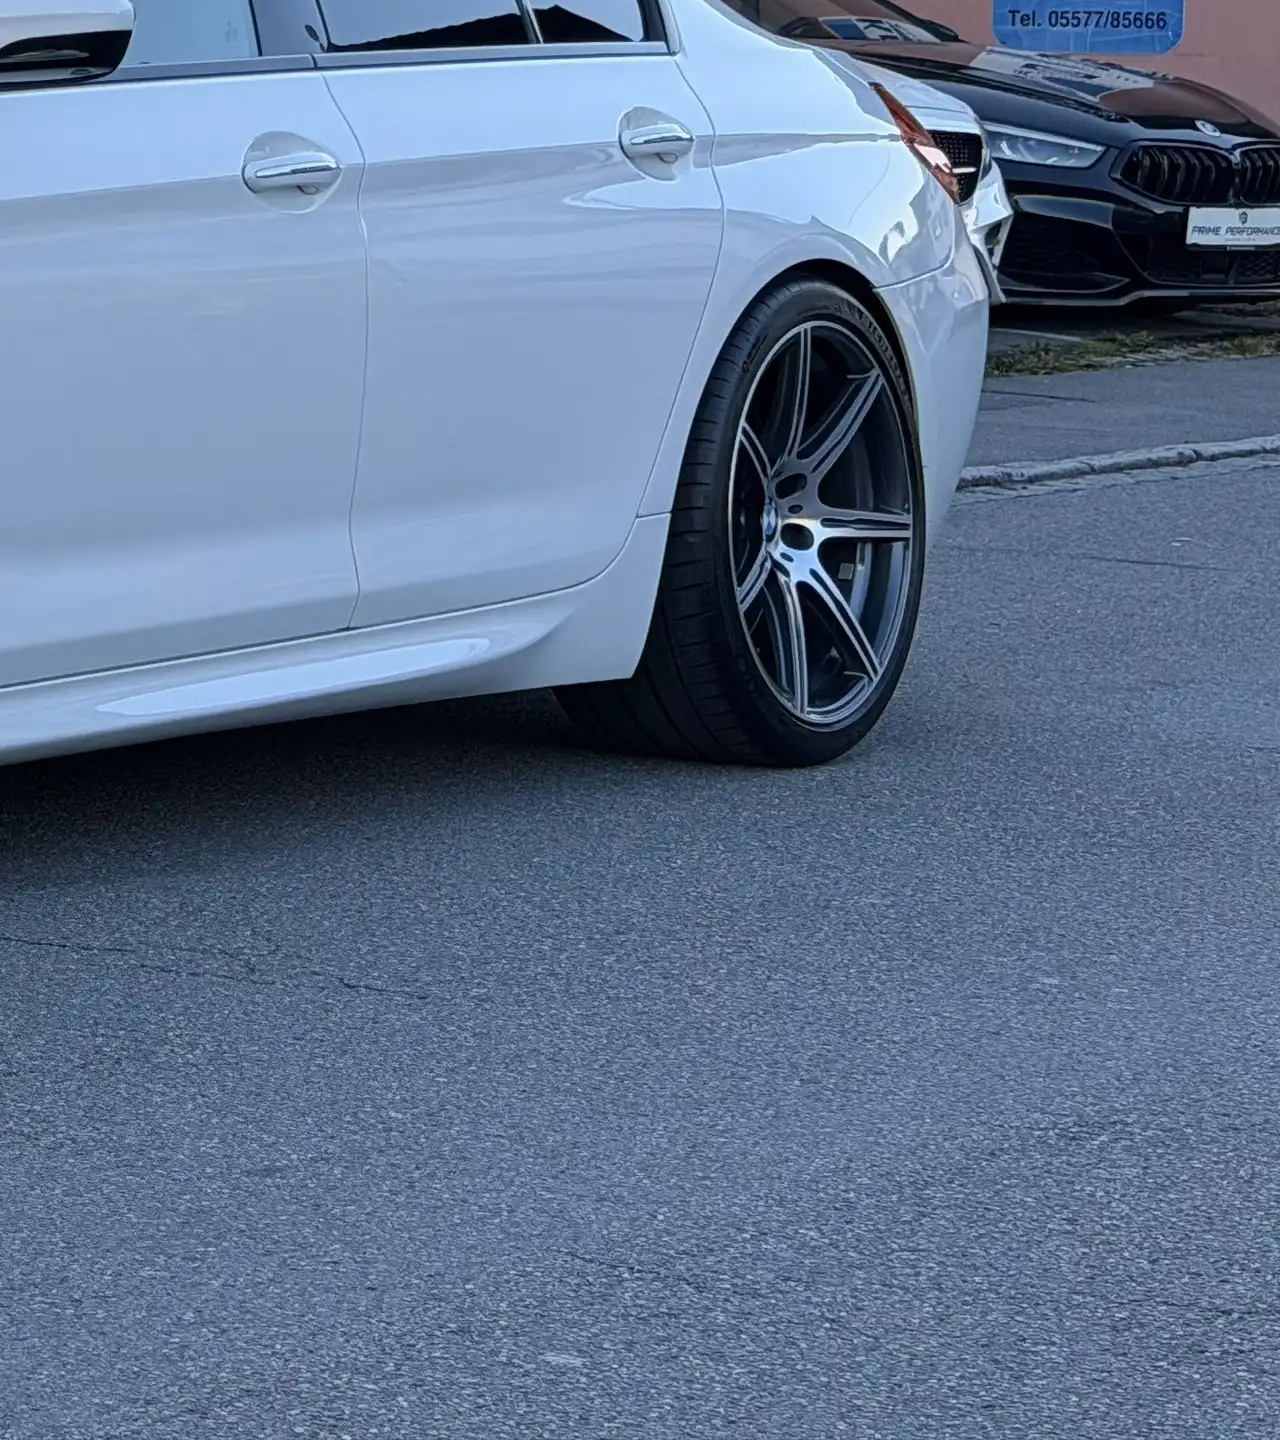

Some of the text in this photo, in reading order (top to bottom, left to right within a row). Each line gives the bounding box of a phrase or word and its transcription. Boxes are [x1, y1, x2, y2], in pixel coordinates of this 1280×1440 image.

[1008, 10, 1167, 29] Tel. 05577/85666
[1191, 225, 1221, 236] PRIME
